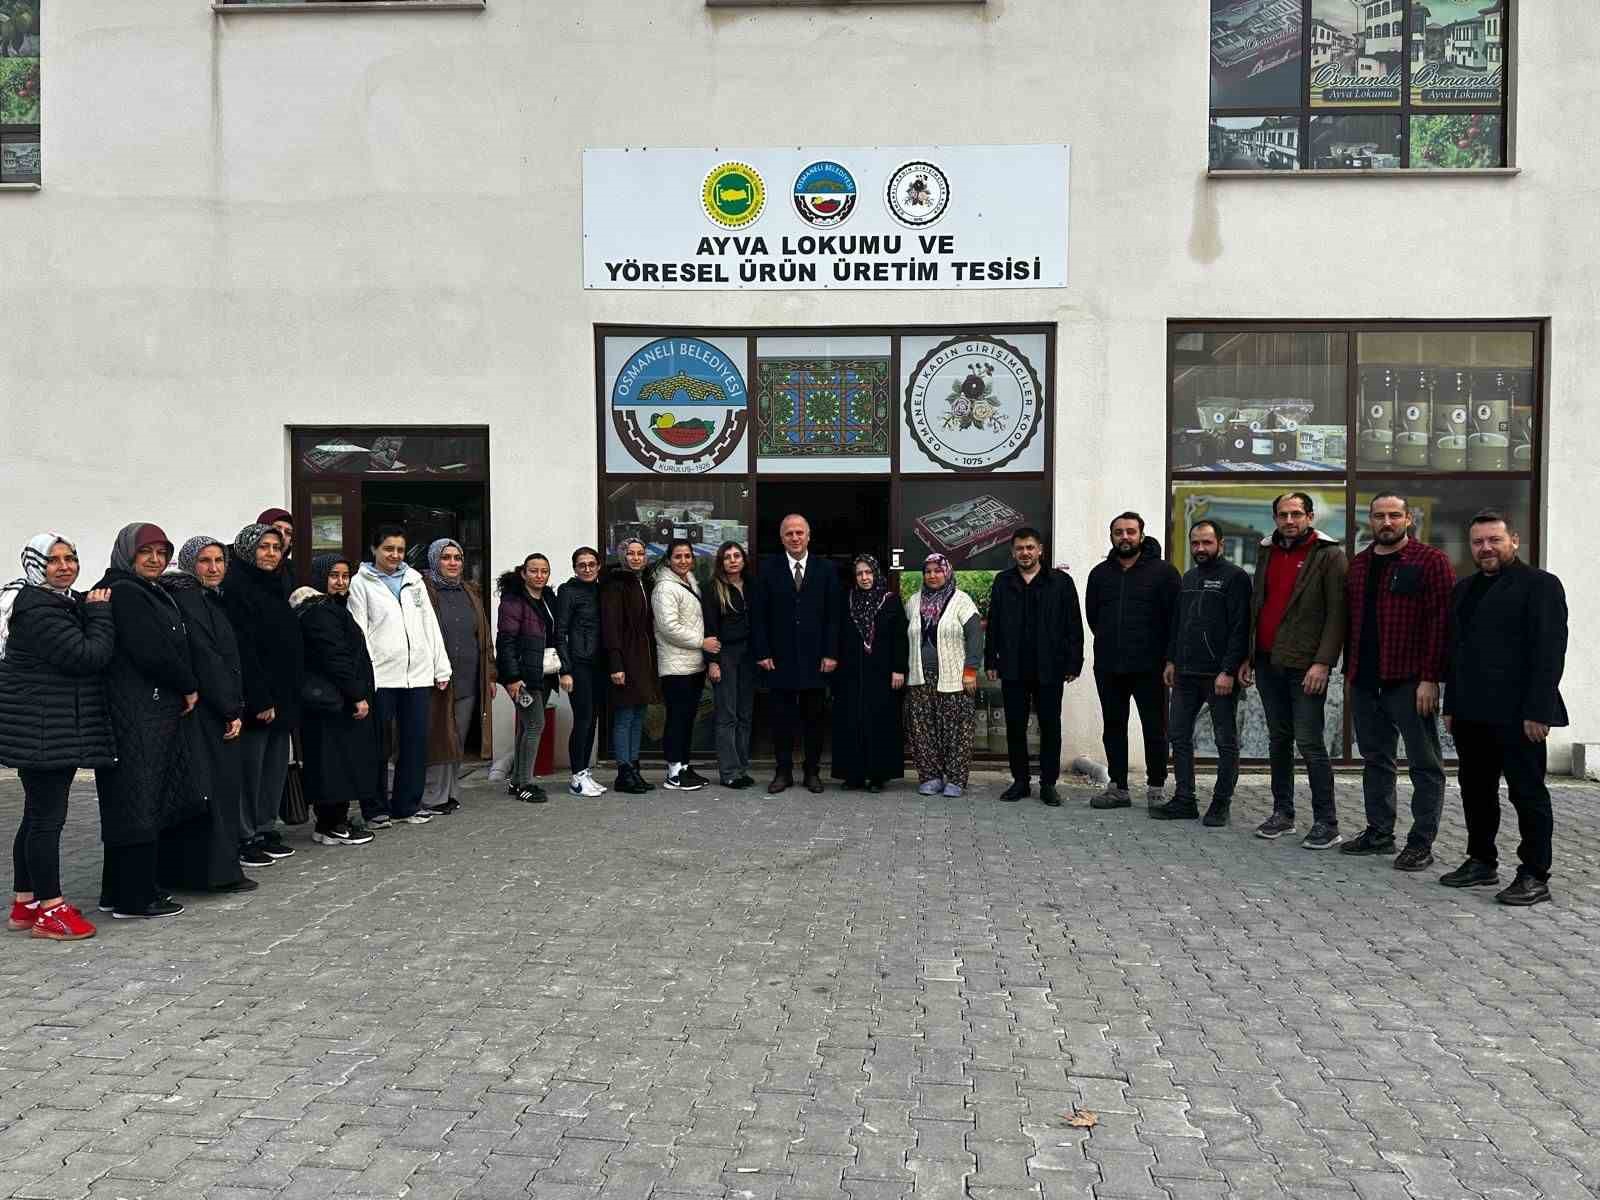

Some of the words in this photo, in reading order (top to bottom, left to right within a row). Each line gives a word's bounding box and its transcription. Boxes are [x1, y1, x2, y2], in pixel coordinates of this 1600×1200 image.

[696, 236, 769, 256] AYVA
[782, 235, 901, 255] LOKUMU
[918, 235, 954, 254] VE
[605, 259, 729, 282] YÖRESEL
[739, 258, 816, 282] ÜRÜN
[833, 257, 938, 281] ÜRETİM
[952, 256, 1041, 281] TESİSİ
[618, 341, 675, 396] OSMANELİ
[922, 348, 959, 379] KADIN
[966, 343, 1033, 406] GİRİŞİMCİLER
[914, 384, 941, 452] OSMANELİ
[963, 457, 983, 465] 1075
